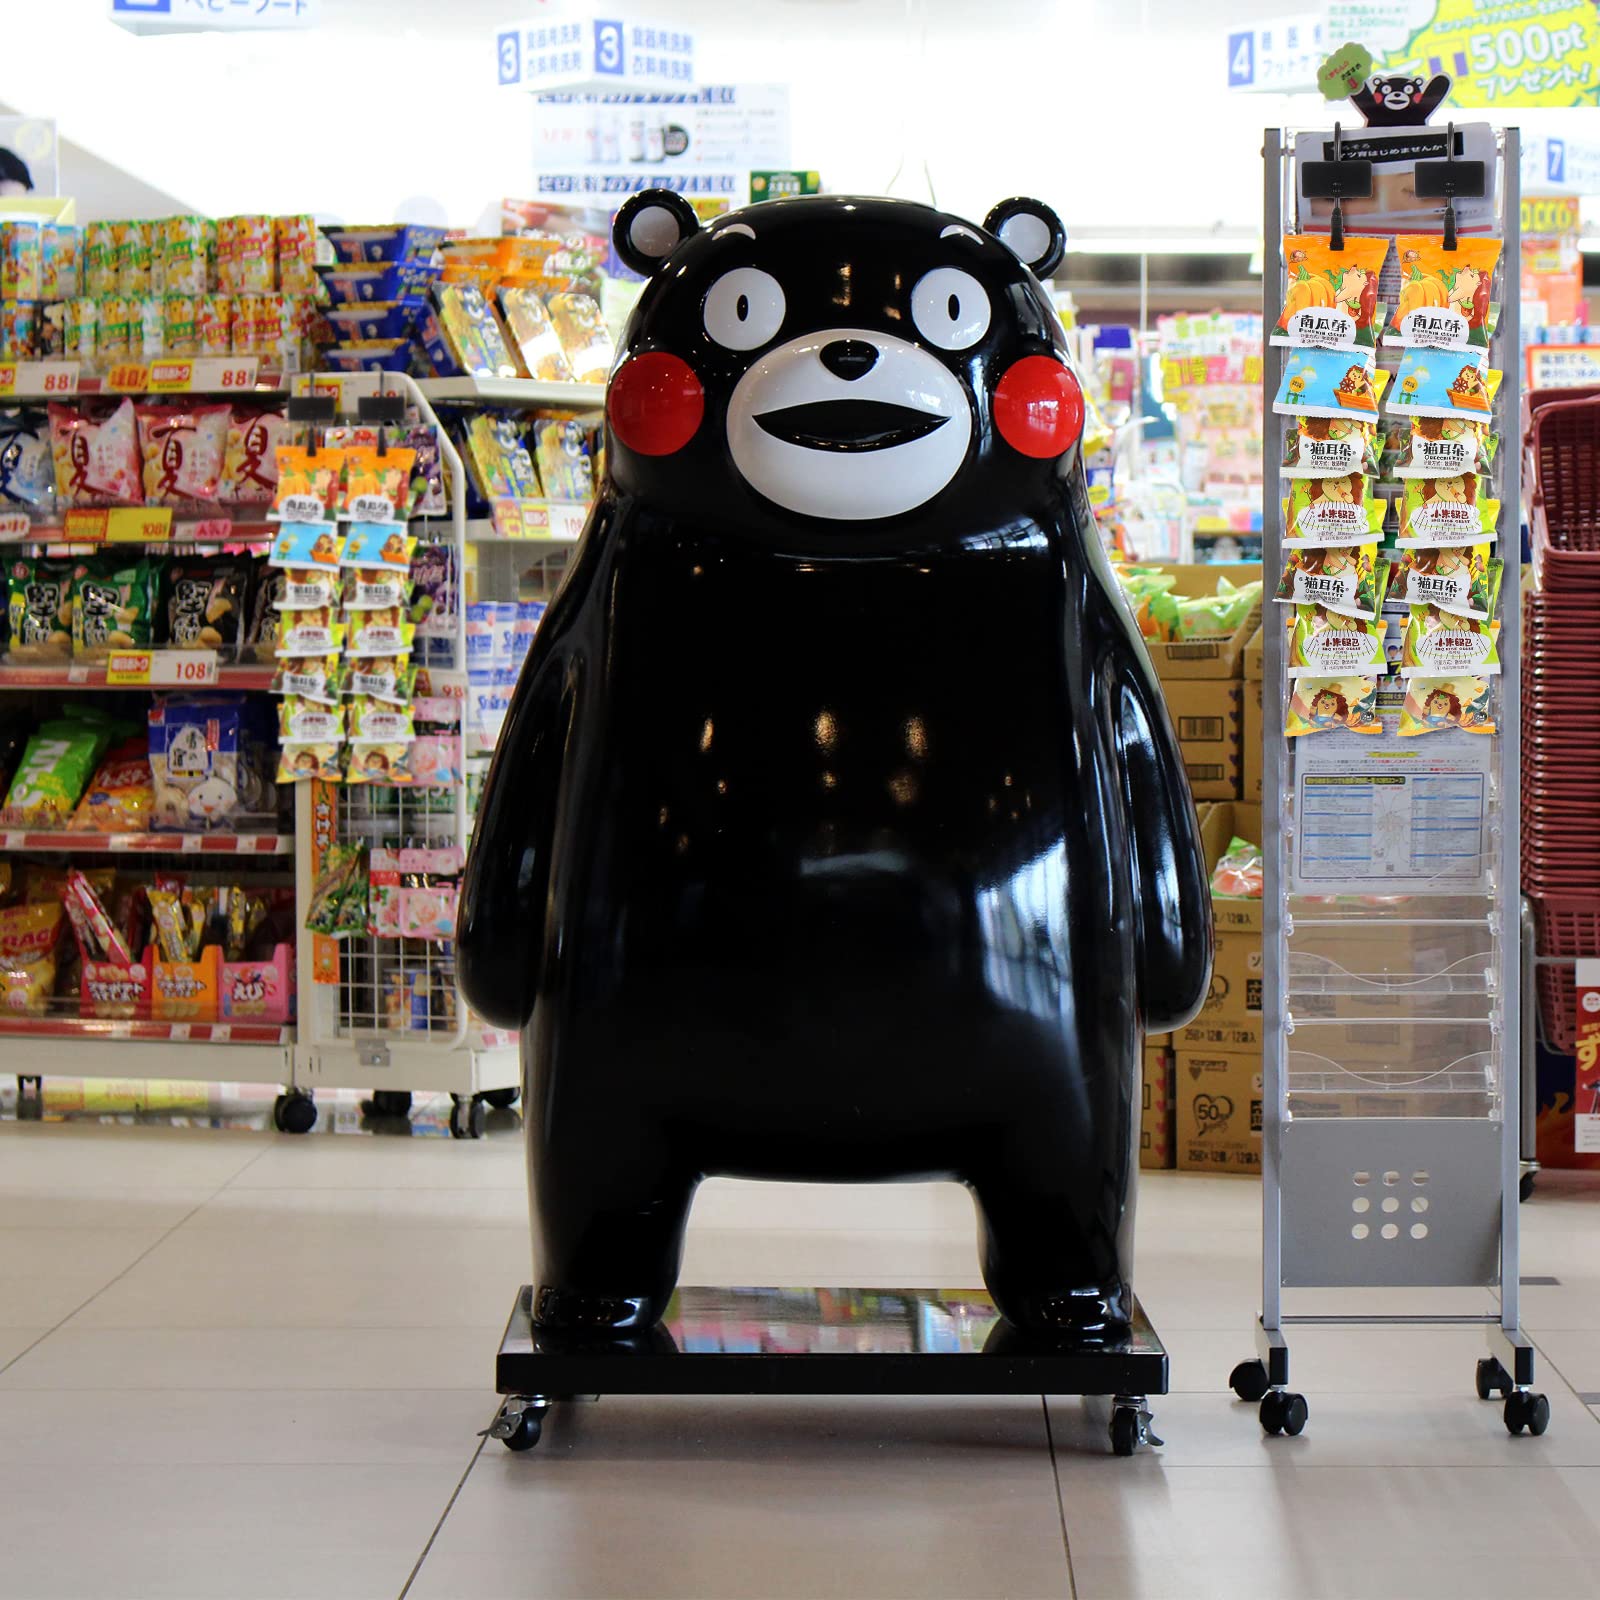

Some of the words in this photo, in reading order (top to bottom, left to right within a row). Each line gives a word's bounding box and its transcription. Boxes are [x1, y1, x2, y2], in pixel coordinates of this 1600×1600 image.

[599, 25, 619, 68] 3
[1470, 22, 1588, 73] 500pt
[501, 37, 517, 80] 3
[1231, 38, 1250, 80] 4
[1476, 62, 1592, 101] プレゼント!
[1550, 143, 1562, 176] 7
[1300, 314, 1348, 333] 南瓜酥
[1413, 314, 1461, 333] 南瓜酥
[44, 373, 69, 391] 88
[222, 369, 247, 387] 88
[1310, 442, 1352, 457] 猫耳朵
[1423, 442, 1465, 457] 猫耳朵
[1317, 508, 1357, 520] 小米锅巴
[1430, 508, 1470, 520] 小米锅巴
[1304, 575, 1345, 593] 猫耳朵
[1417, 575, 1458, 593] 猫耳朵
[1322, 637, 1360, 647] 小米锅巴
[1435, 637, 1473, 647] 小米锅巴
[175, 662, 206, 680] 108
[441, 685, 463, 698] 98
[1198, 1104, 1219, 1120] 50
